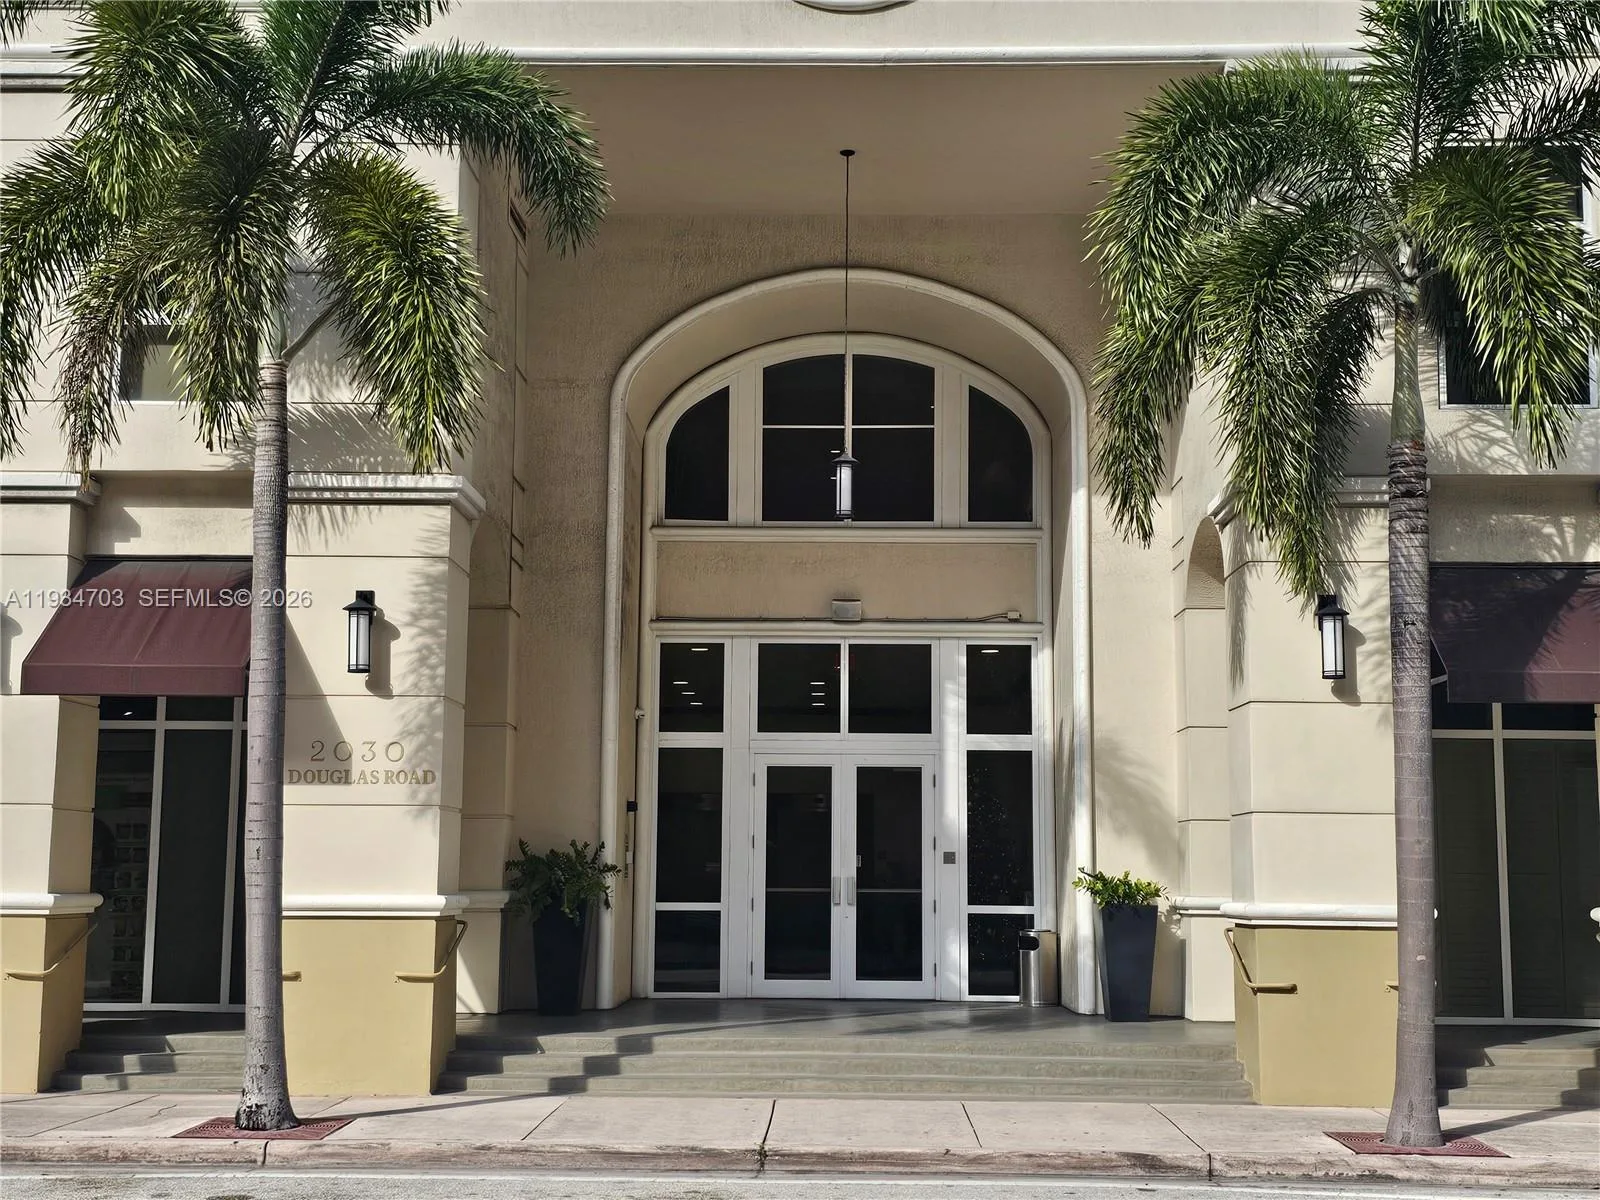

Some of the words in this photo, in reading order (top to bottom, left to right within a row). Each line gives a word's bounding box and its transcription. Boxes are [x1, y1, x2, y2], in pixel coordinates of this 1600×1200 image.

[310, 740, 405, 763] 2030
[287, 768, 380, 785] DOUGLAS
[383, 769, 437, 785] ROAD
